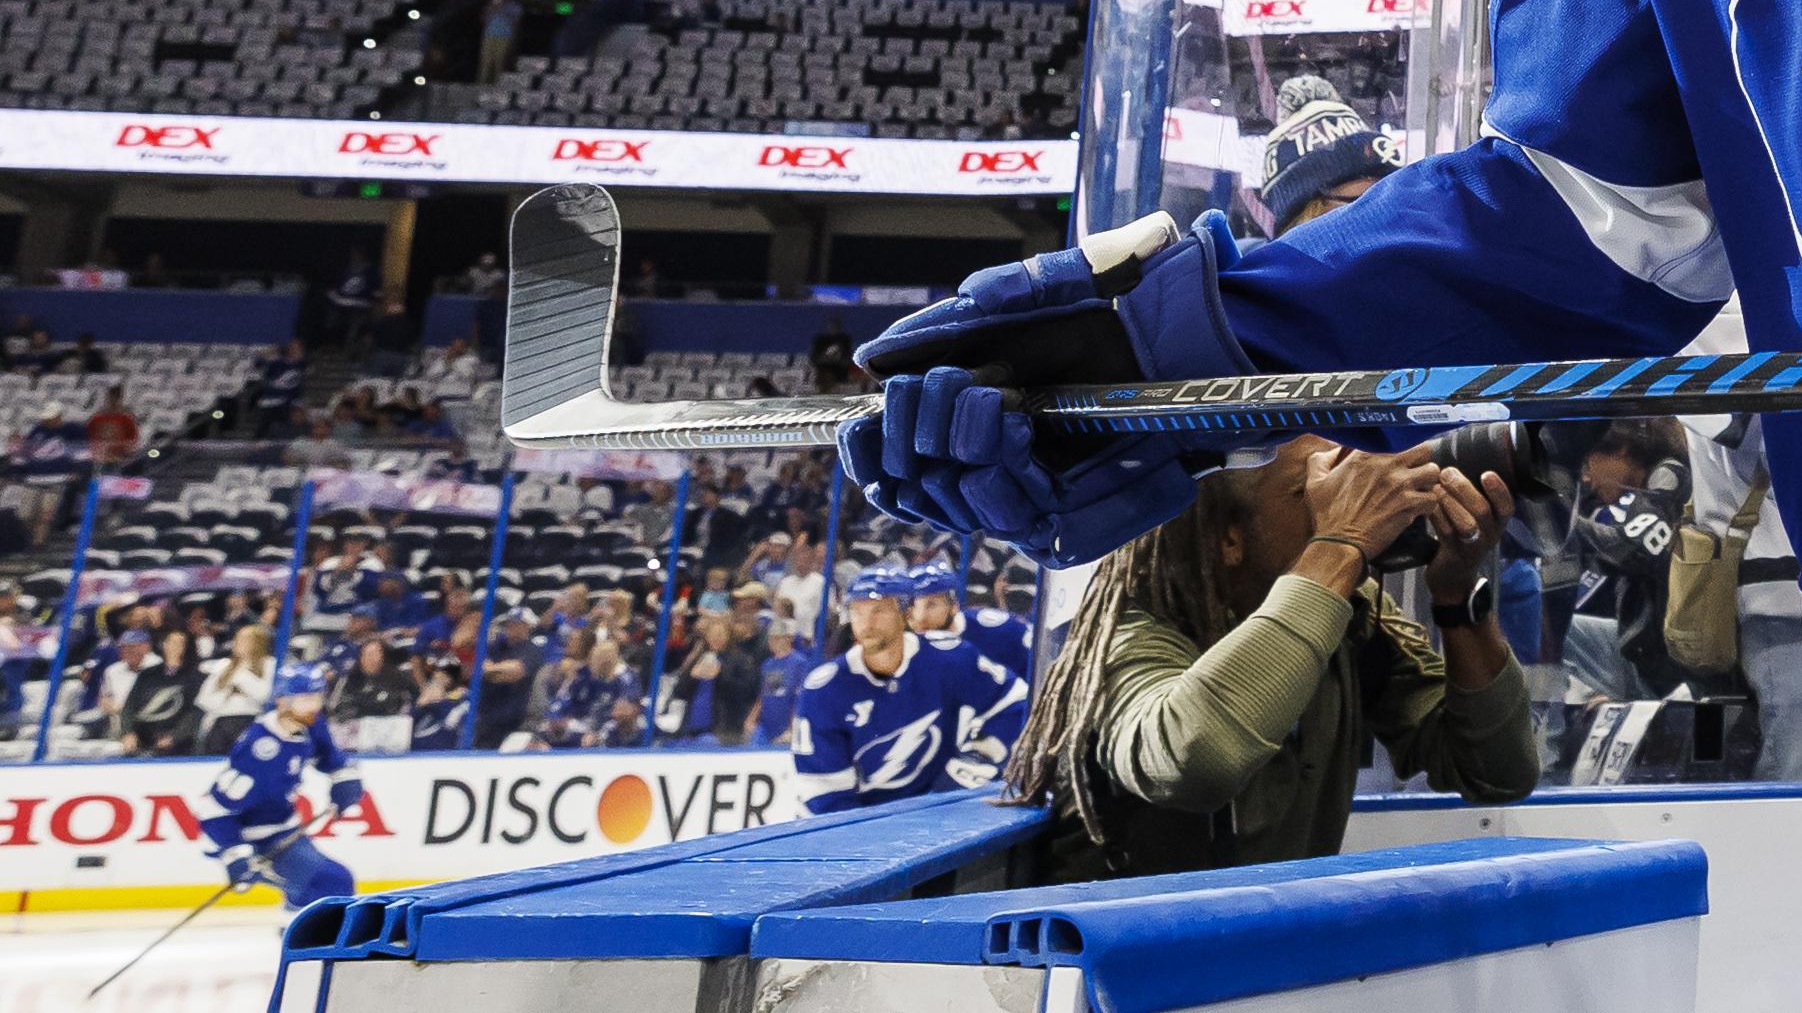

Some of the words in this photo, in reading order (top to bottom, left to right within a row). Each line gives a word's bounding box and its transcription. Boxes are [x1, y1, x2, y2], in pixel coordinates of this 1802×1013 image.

[115, 125, 222, 148] DEX
[337, 132, 443, 156] DEX
[552, 139, 650, 162] DEX
[758, 145, 854, 168] DEX
[958, 150, 1045, 172] DEX
[1172, 372, 1367, 402] COVERT
[1624, 512, 1673, 556] 88
[0, 792, 396, 846] HONA
[424, 773, 776, 844] DISCOVER
